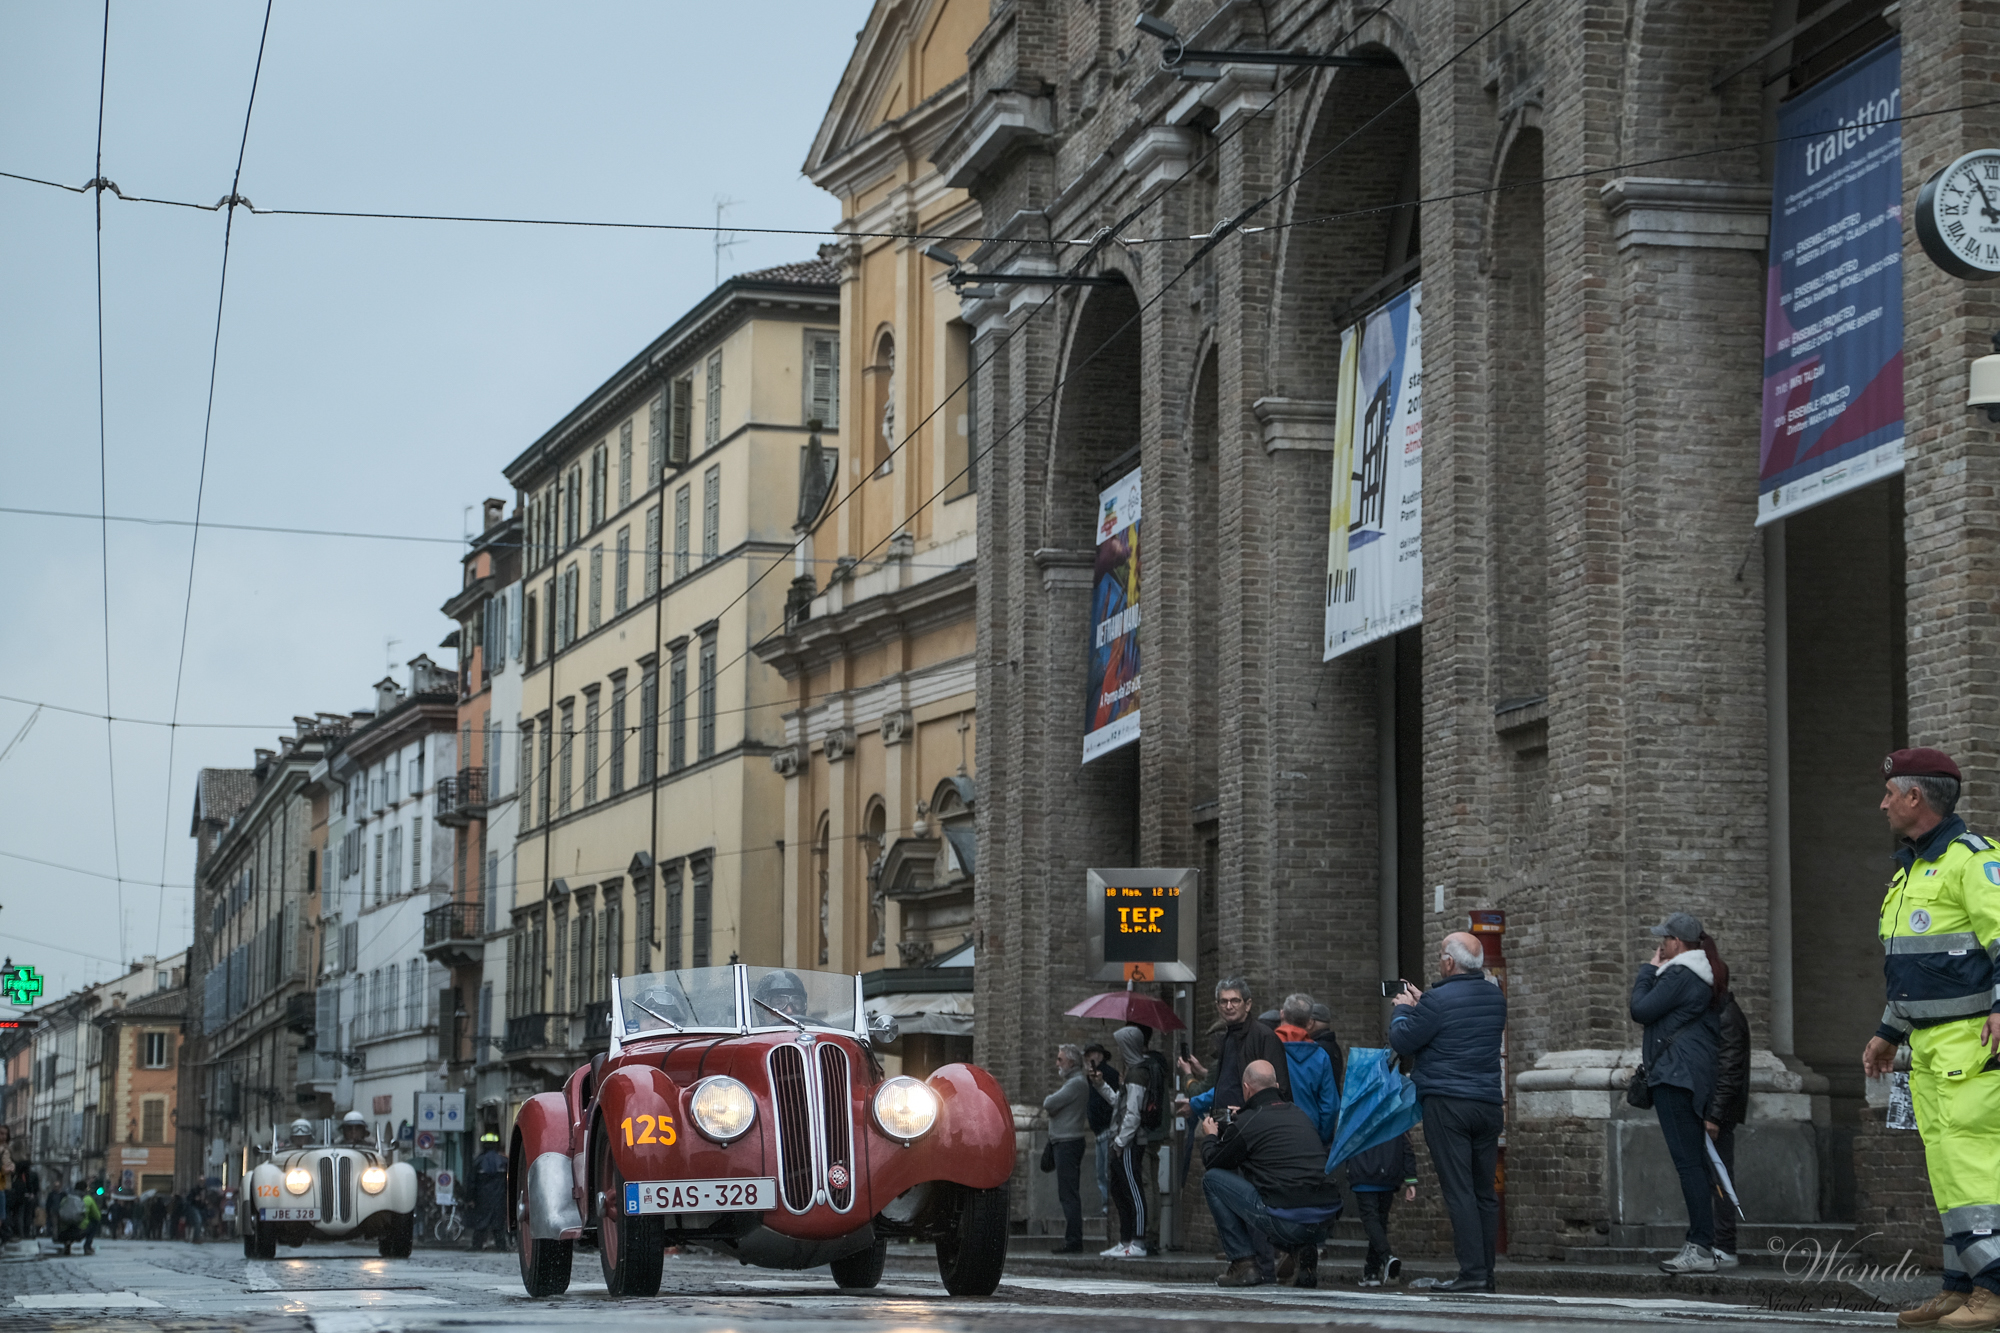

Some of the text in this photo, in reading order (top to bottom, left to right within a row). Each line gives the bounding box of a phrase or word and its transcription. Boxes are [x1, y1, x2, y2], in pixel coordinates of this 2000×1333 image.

[1984, 165, 1999, 180] XII
[1117, 907, 1164, 923] TEP
[1120, 923, 1162, 933] S.p.A.
[620, 1114, 677, 1147] 125
[257, 1185, 280, 1198] 126
[628, 1200, 638, 1211] B
[272, 1210, 314, 1219] JBE 328
